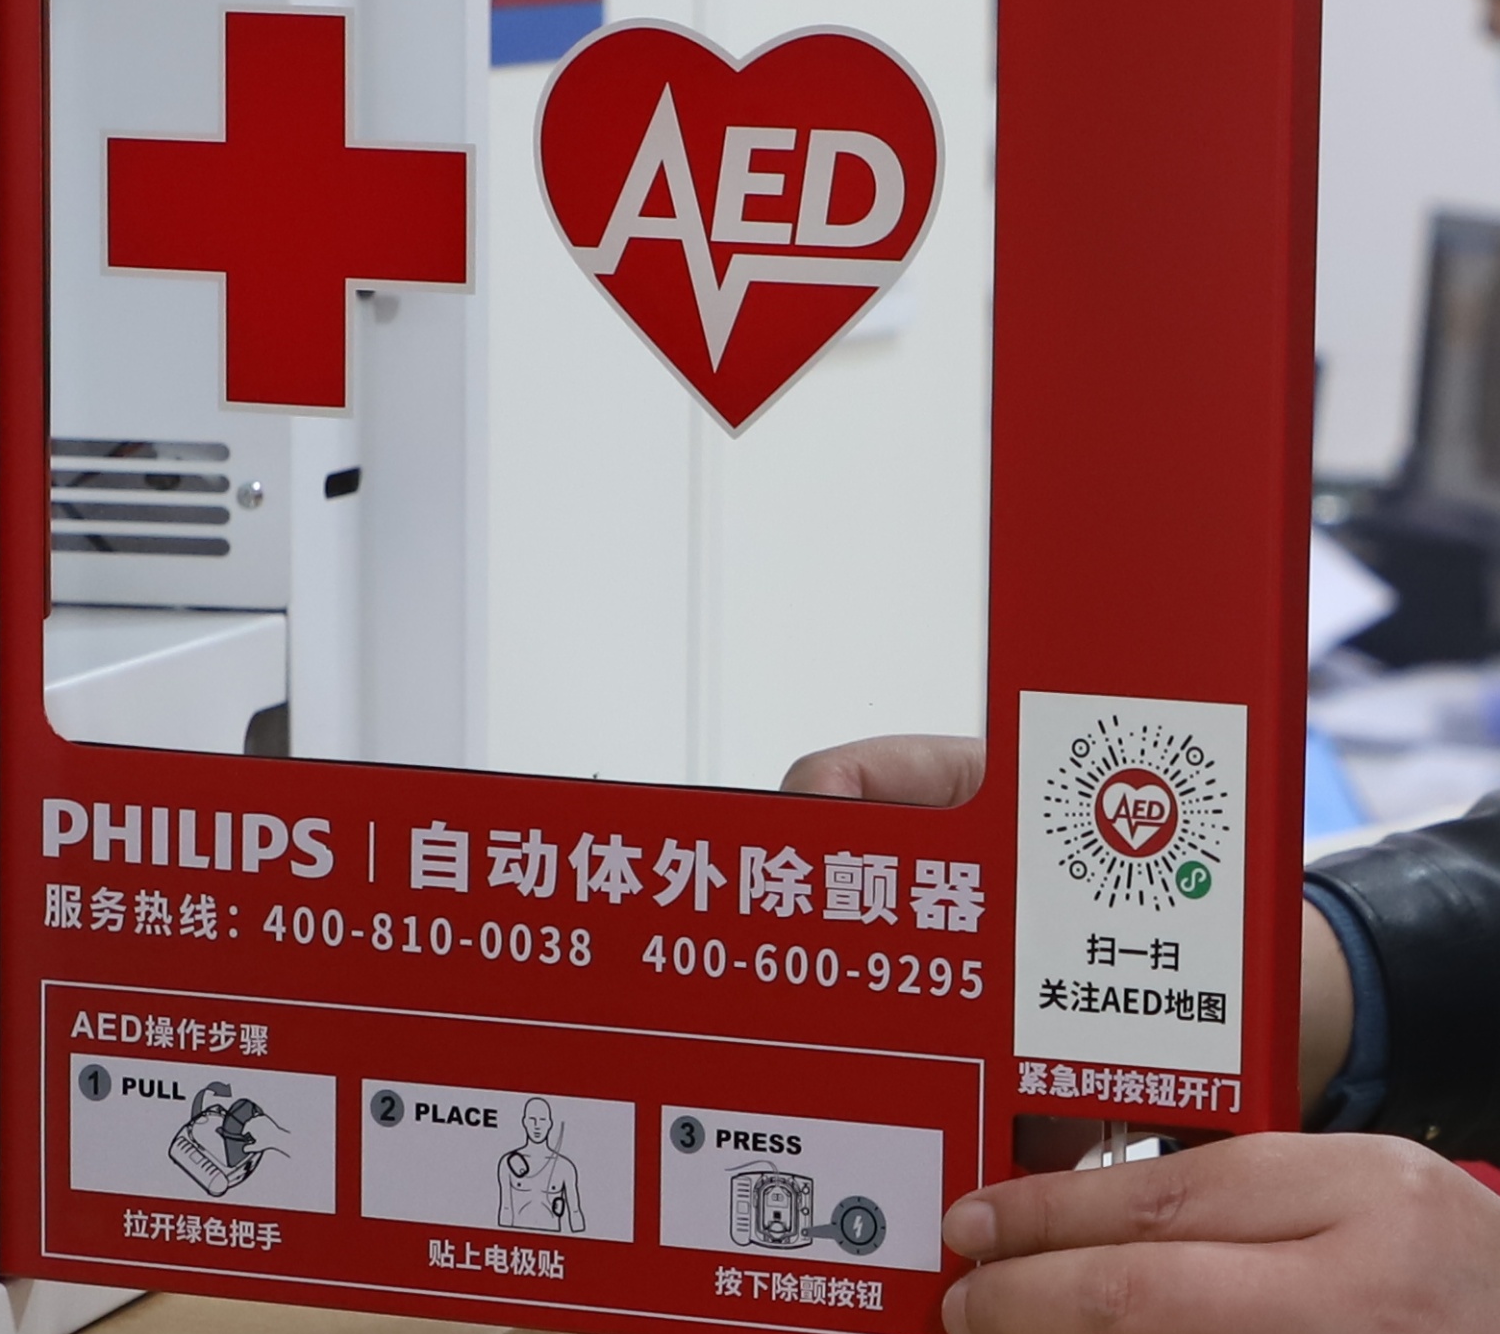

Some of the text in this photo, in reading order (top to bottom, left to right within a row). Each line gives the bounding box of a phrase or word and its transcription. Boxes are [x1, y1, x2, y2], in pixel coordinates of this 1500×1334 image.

[595, 82, 905, 327] AED
[1109, 793, 1166, 829] AED
[43, 799, 986, 933] PHILIPS 自动体外除颤器
[642, 935, 983, 999] 400-600-9295
[1087, 933, 1179, 971] 扫一扫
[1039, 978, 1226, 1024] 关注AED地图
[71, 1011, 274, 1063] AED操作步骤
[123, 1077, 186, 1100] PULL
[1018, 1058, 1240, 1112] 紧急时按钮开门
[415, 1103, 497, 1128] PLACE
[716, 1129, 801, 1155] PRESS
[124, 1208, 281, 1250] 拉开绿色把手
[429, 1236, 564, 1279] 贴上电极贴
[715, 1263, 883, 1310] 按下除颤按钮
